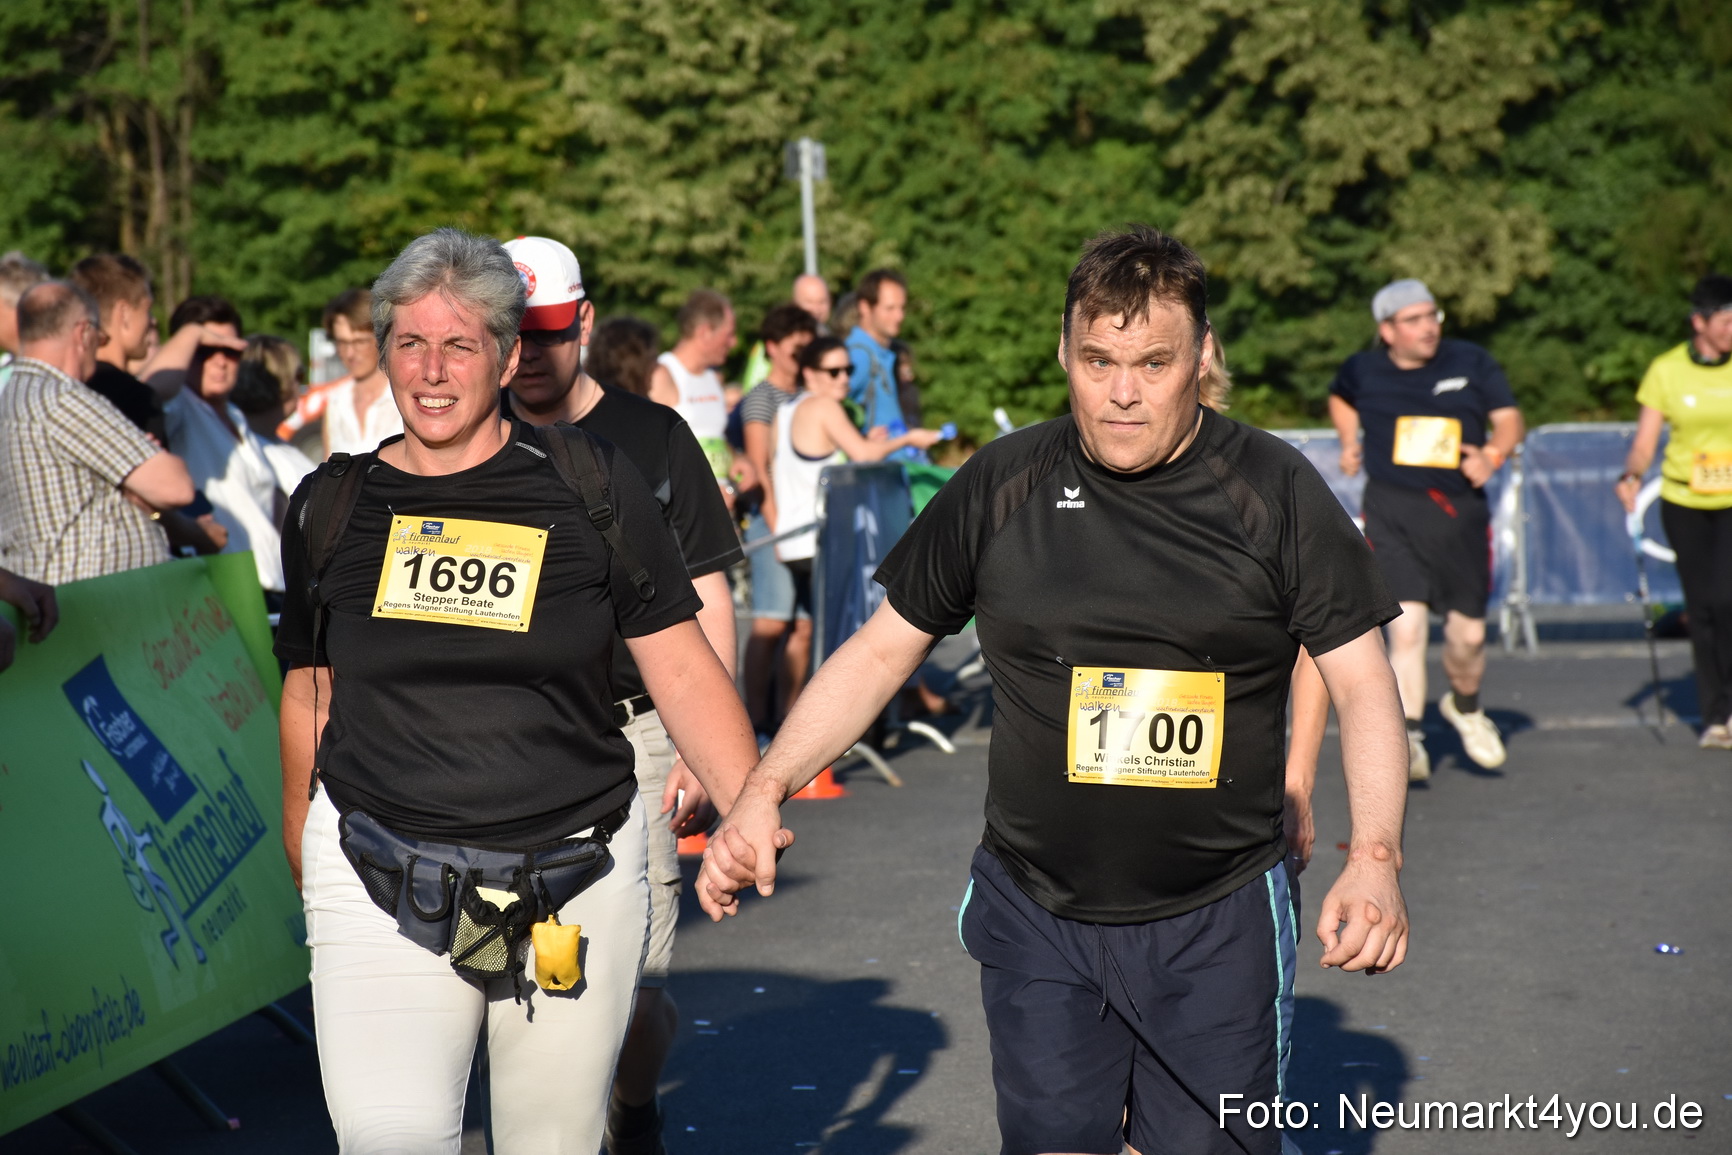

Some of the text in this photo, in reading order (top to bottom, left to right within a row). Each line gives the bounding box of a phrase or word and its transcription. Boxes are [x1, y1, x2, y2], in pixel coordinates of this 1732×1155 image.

[1056, 500, 1085, 508] erima
[409, 532, 461, 545] firmenlauf
[396, 546, 436, 557] walken
[404, 554, 517, 598] 1696
[413, 592, 494, 608] Stepper Beate
[383, 600, 411, 610] Regens
[413, 603, 442, 614] Wagner
[444, 606, 474, 616] Stiftung
[474, 609, 520, 620] Lauterhofen
[1092, 686, 1140, 696] firmenlau
[1080, 701, 1120, 712] walken
[1090, 710, 1204, 755] 1700
[1144, 755, 1196, 768] Christian
[1076, 764, 1104, 772] Regens
[1136, 766, 1167, 777] Stiftung
[1168, 769, 1210, 778] Lauterhofen
[145, 748, 267, 912] firmenlauf
